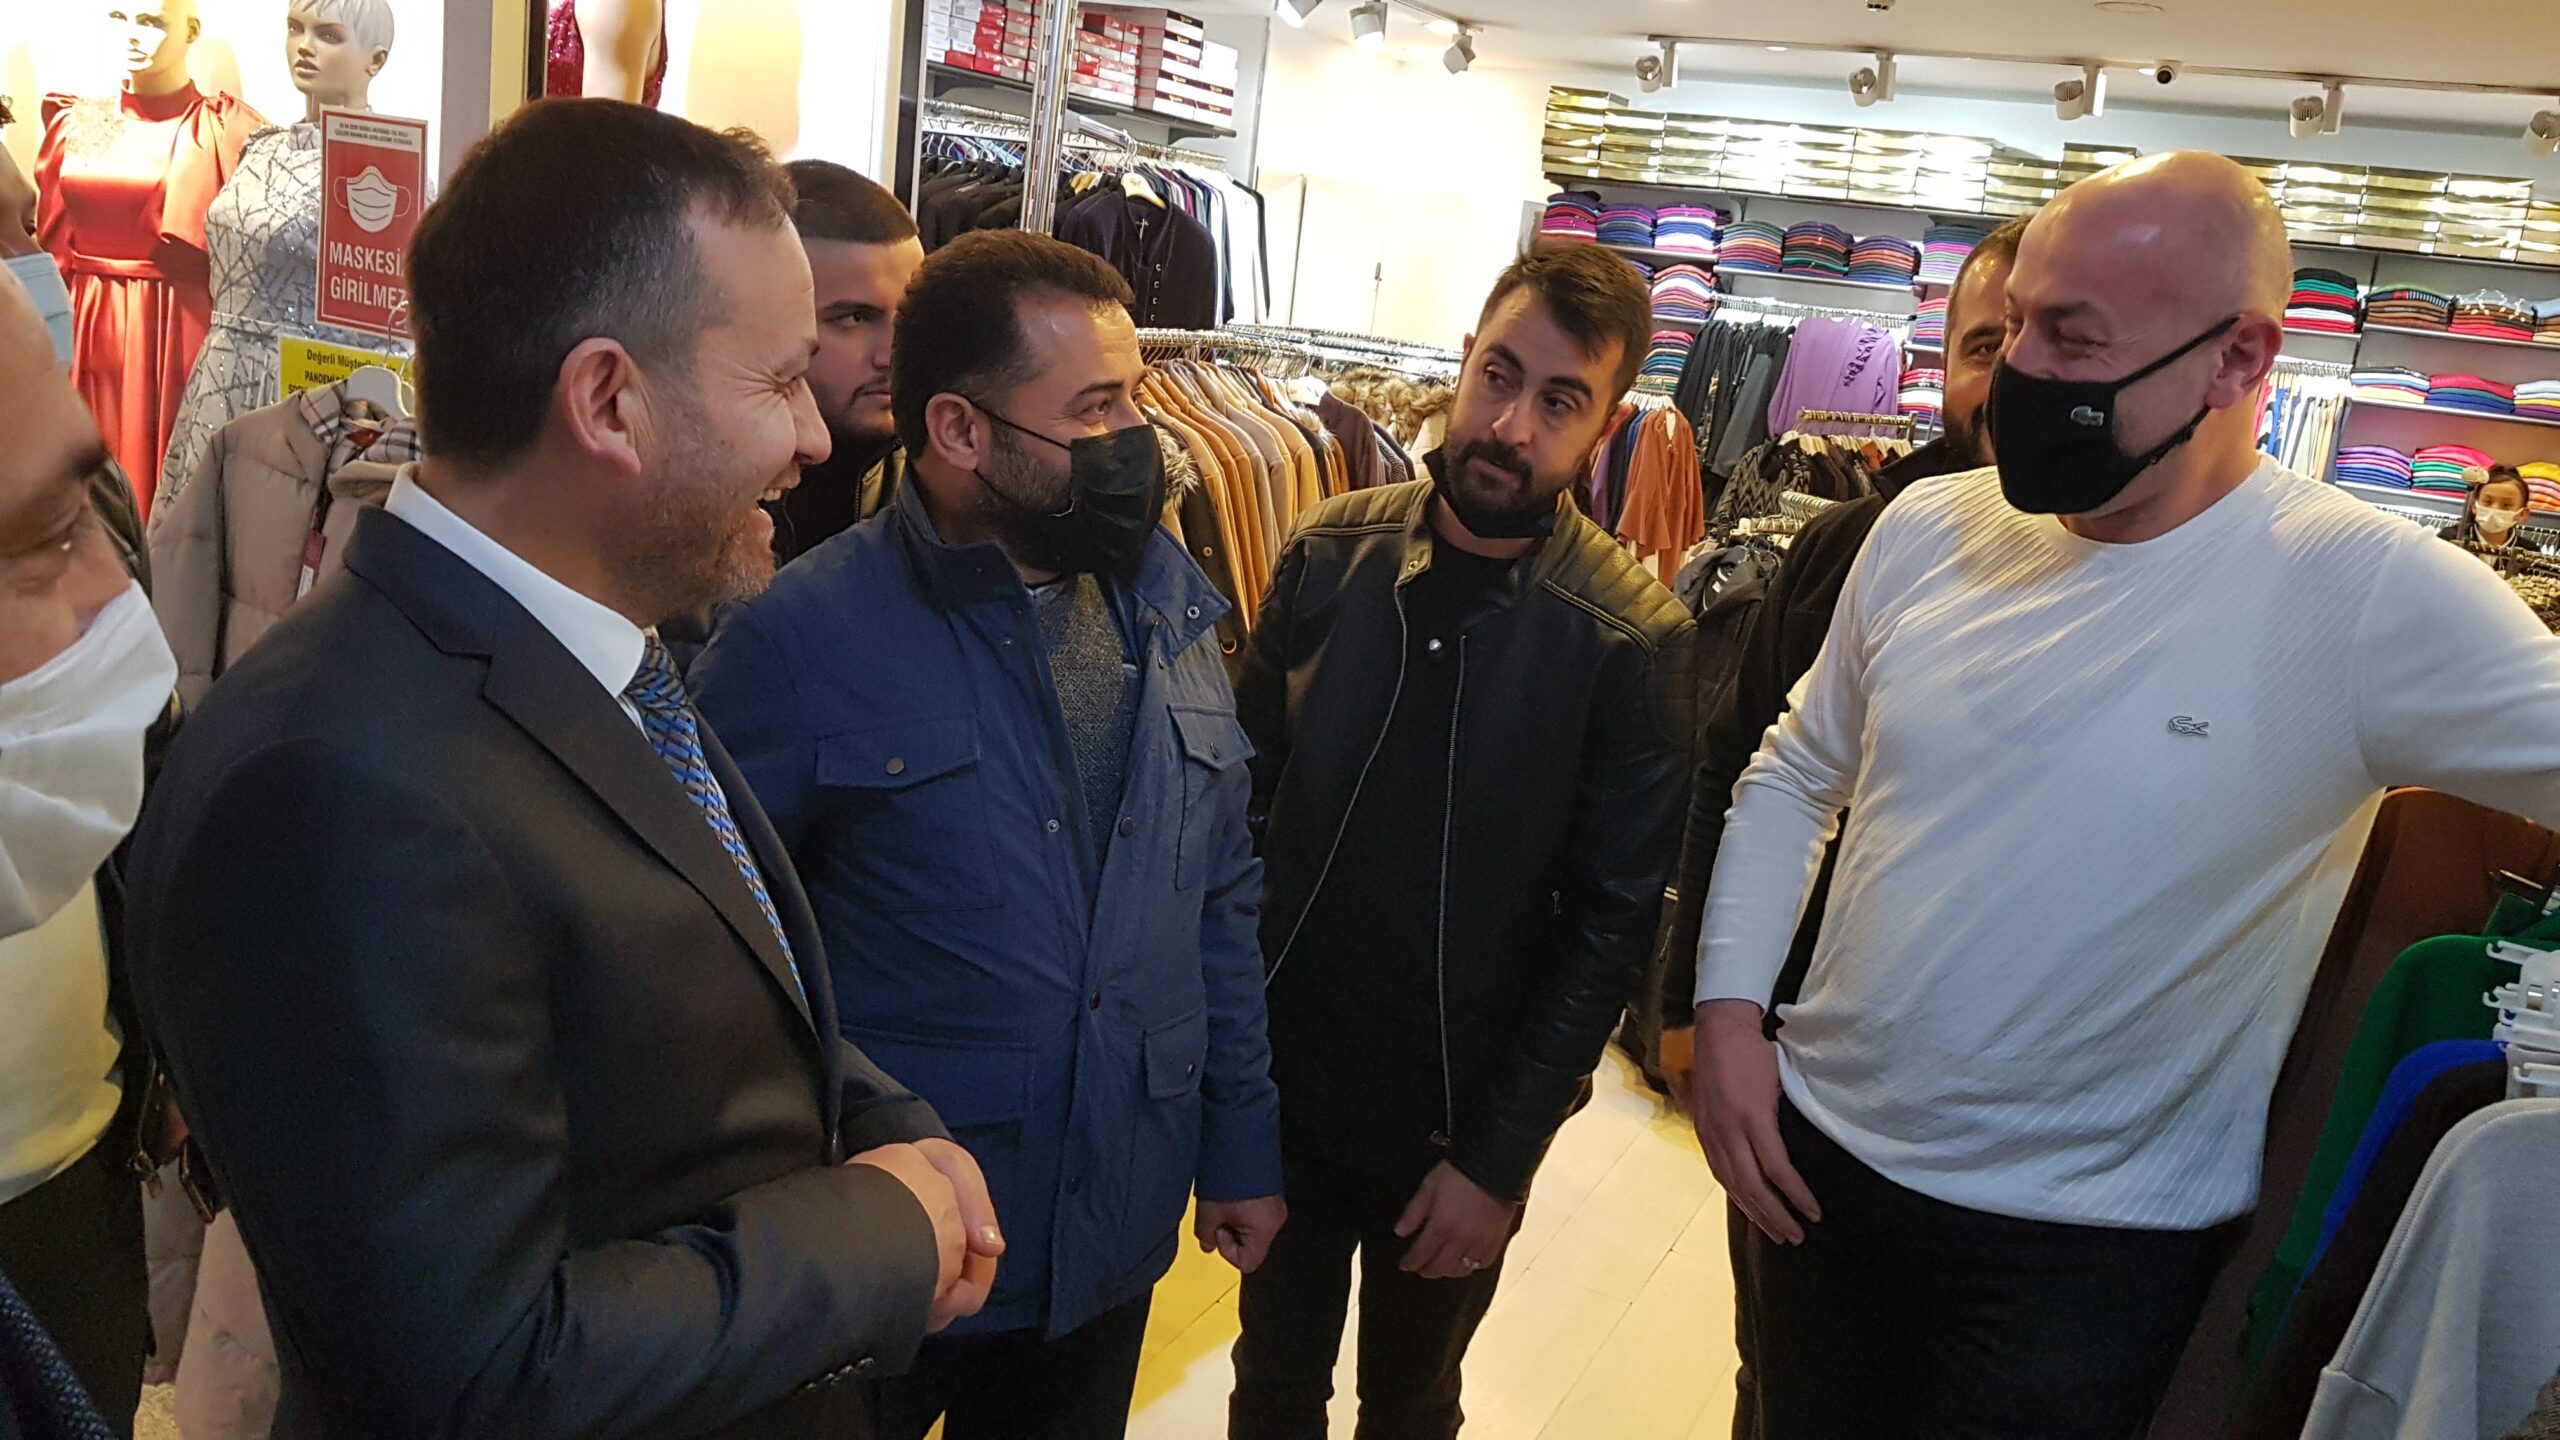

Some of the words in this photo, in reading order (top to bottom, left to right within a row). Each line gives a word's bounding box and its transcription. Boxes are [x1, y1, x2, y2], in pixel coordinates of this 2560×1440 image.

[329, 240, 404, 276] MASKESİ
[330, 273, 407, 312] GİRİLMEZ
[307, 349, 336, 365] Değerli
